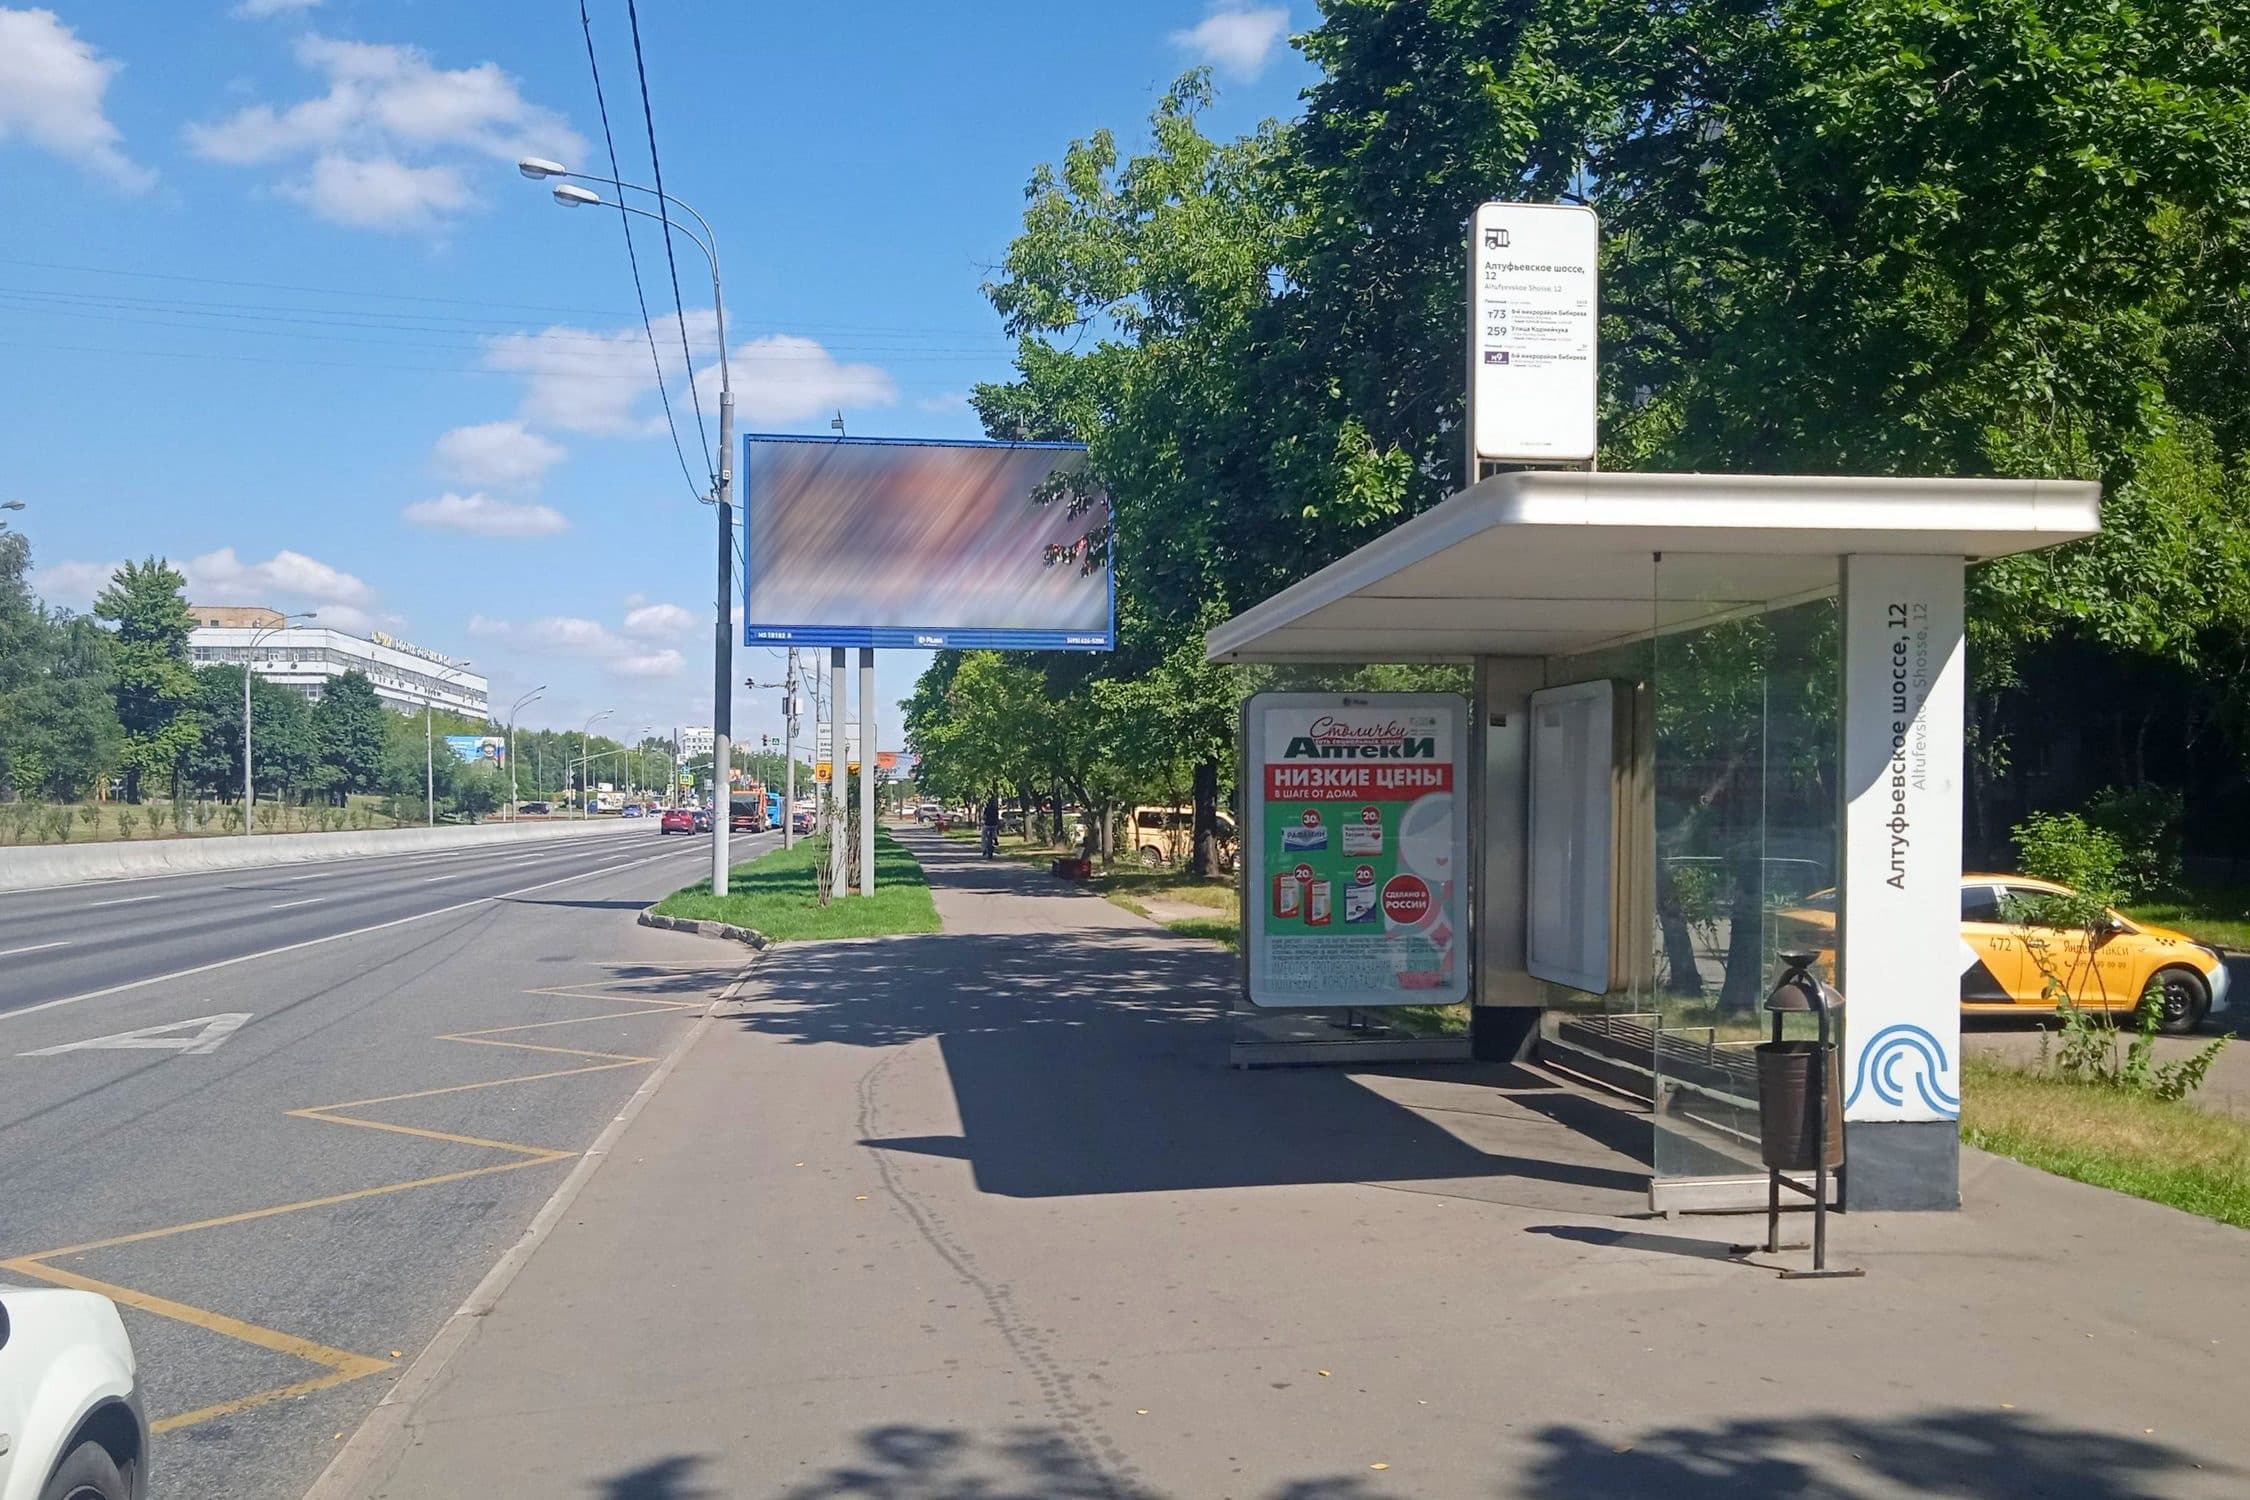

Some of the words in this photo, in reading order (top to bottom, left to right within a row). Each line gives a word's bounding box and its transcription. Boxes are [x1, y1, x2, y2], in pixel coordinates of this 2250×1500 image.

[1485, 260, 1552, 272] Алтуфьевское
[1554, 264, 1585, 274] шоссе,
[1485, 272, 1497, 280] 12
[1487, 326, 1507, 336] 259
[1889, 603, 1907, 629] 12
[1913, 603, 1928, 620] 12
[1912, 627, 1928, 687] Shosse,
[1893, 635, 1909, 713] шоссе,
[1310, 716, 1408, 738] Столички
[1912, 697, 1928, 790] Altufevskoe
[1275, 768, 1370, 786] НИЗКИЕ
[1376, 768, 1443, 789] ЦЕНЫ
[1275, 790, 1281, 798] В
[1283, 790, 1310, 799] ШАГЕ
[1311, 789, 1324, 798] ОТ
[1326, 790, 1358, 799] ДОМА
[1886, 720, 1909, 889] Алтуфьевское
[1385, 891, 1420, 899] СДЕЛАНО
[1385, 901, 1427, 909] РОССИИ
[1990, 937, 2012, 952] 472
[2063, 940, 2095, 954] Янде
